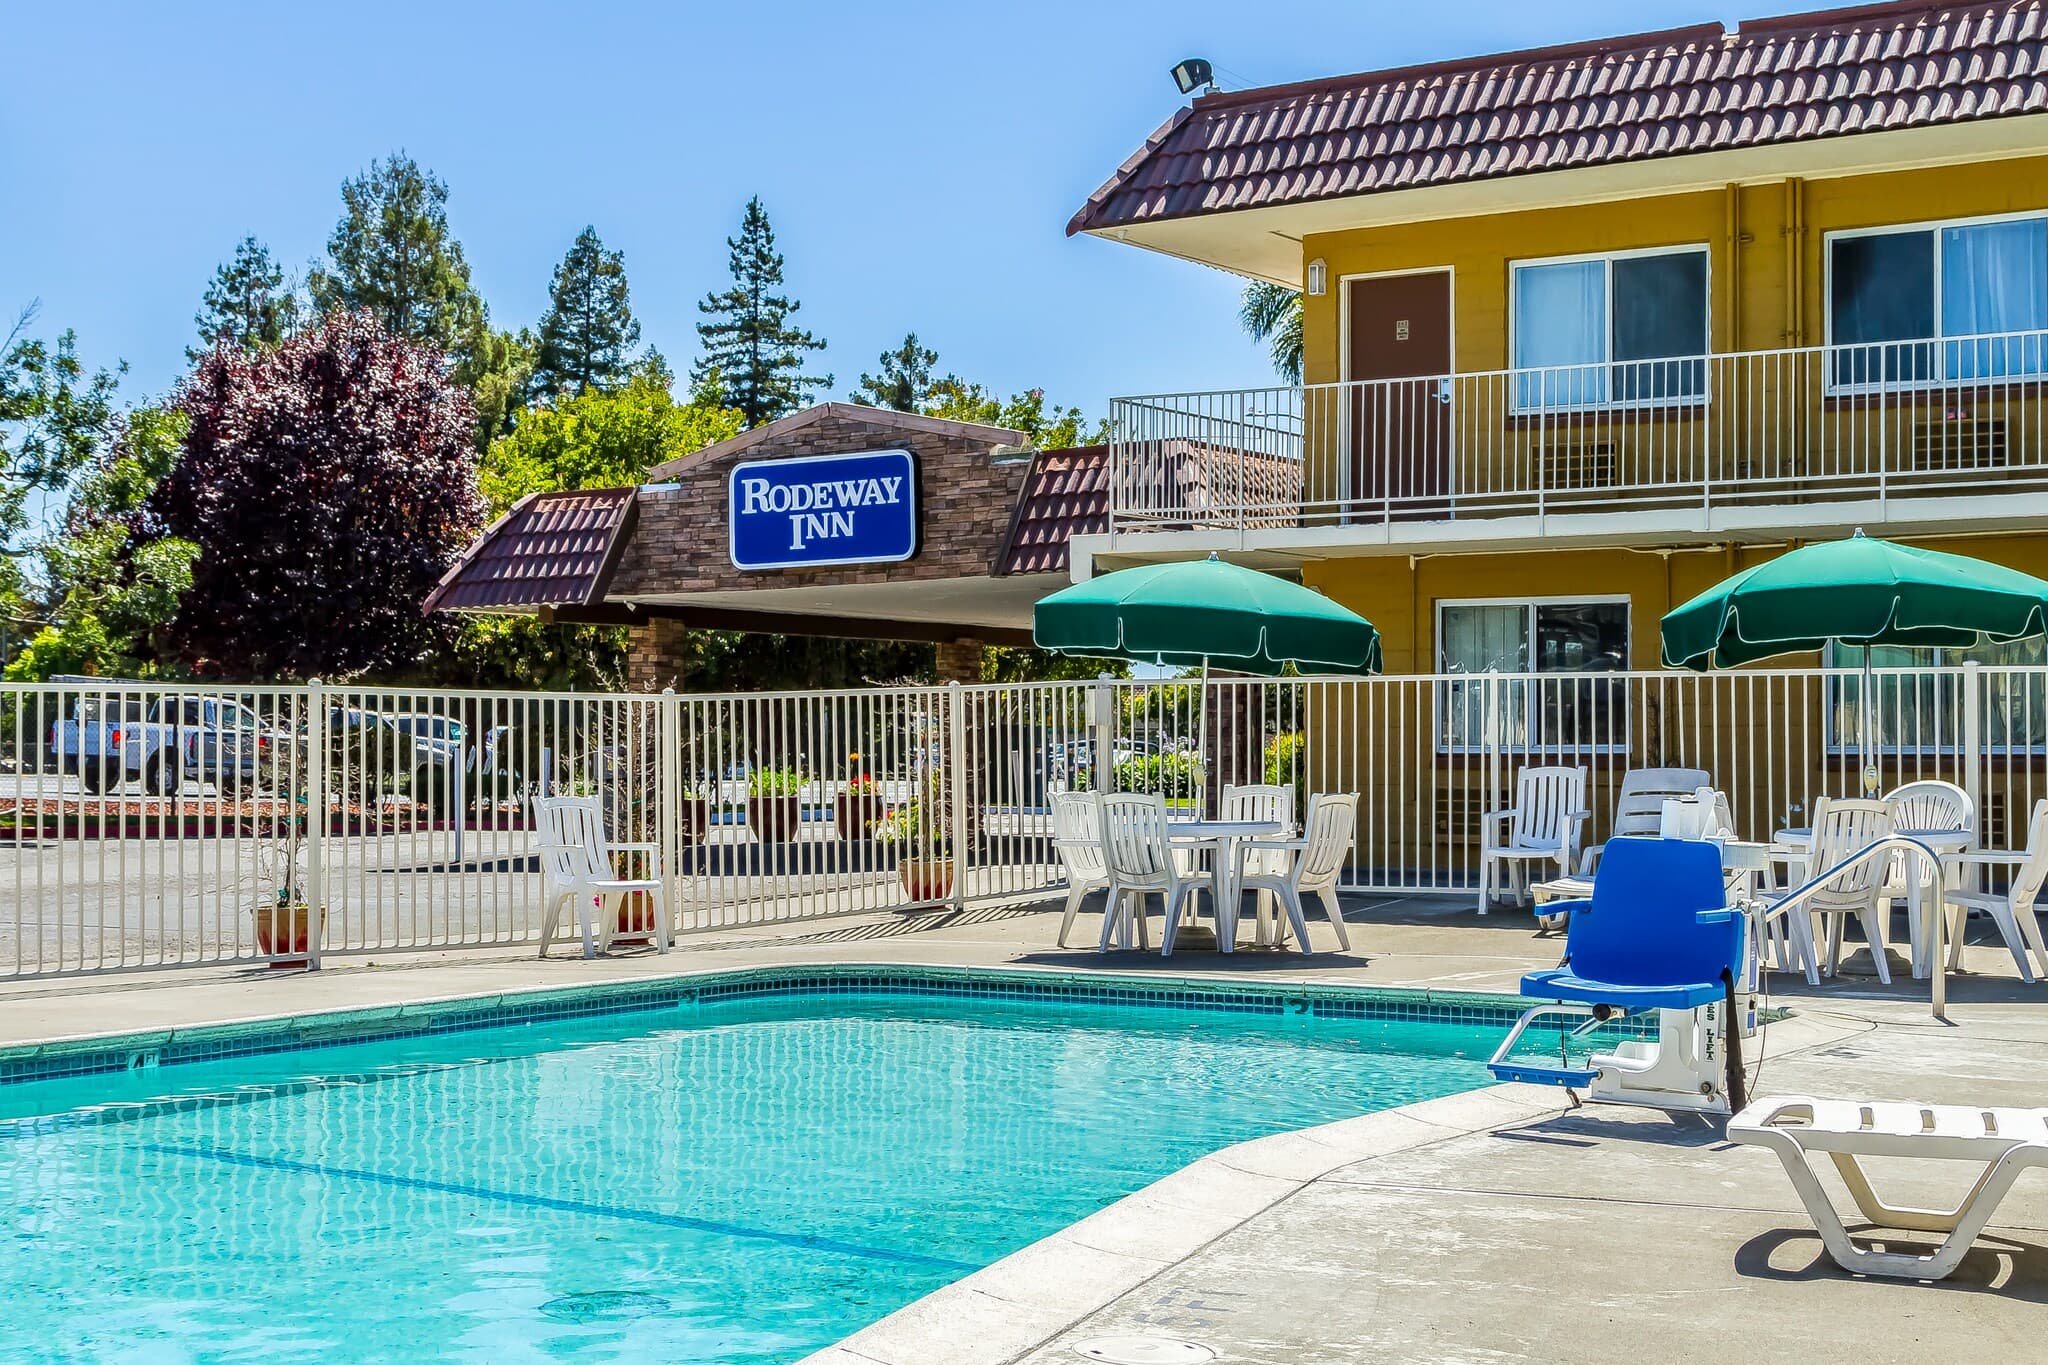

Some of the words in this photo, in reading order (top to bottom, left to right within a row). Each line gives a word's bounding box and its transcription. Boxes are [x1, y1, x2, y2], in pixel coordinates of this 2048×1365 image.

[741, 476, 902, 515] RODEWAY
[789, 511, 855, 550] INN
[1706, 1002, 1716, 1021] ES
[1705, 1028, 1715, 1061] LIFT
